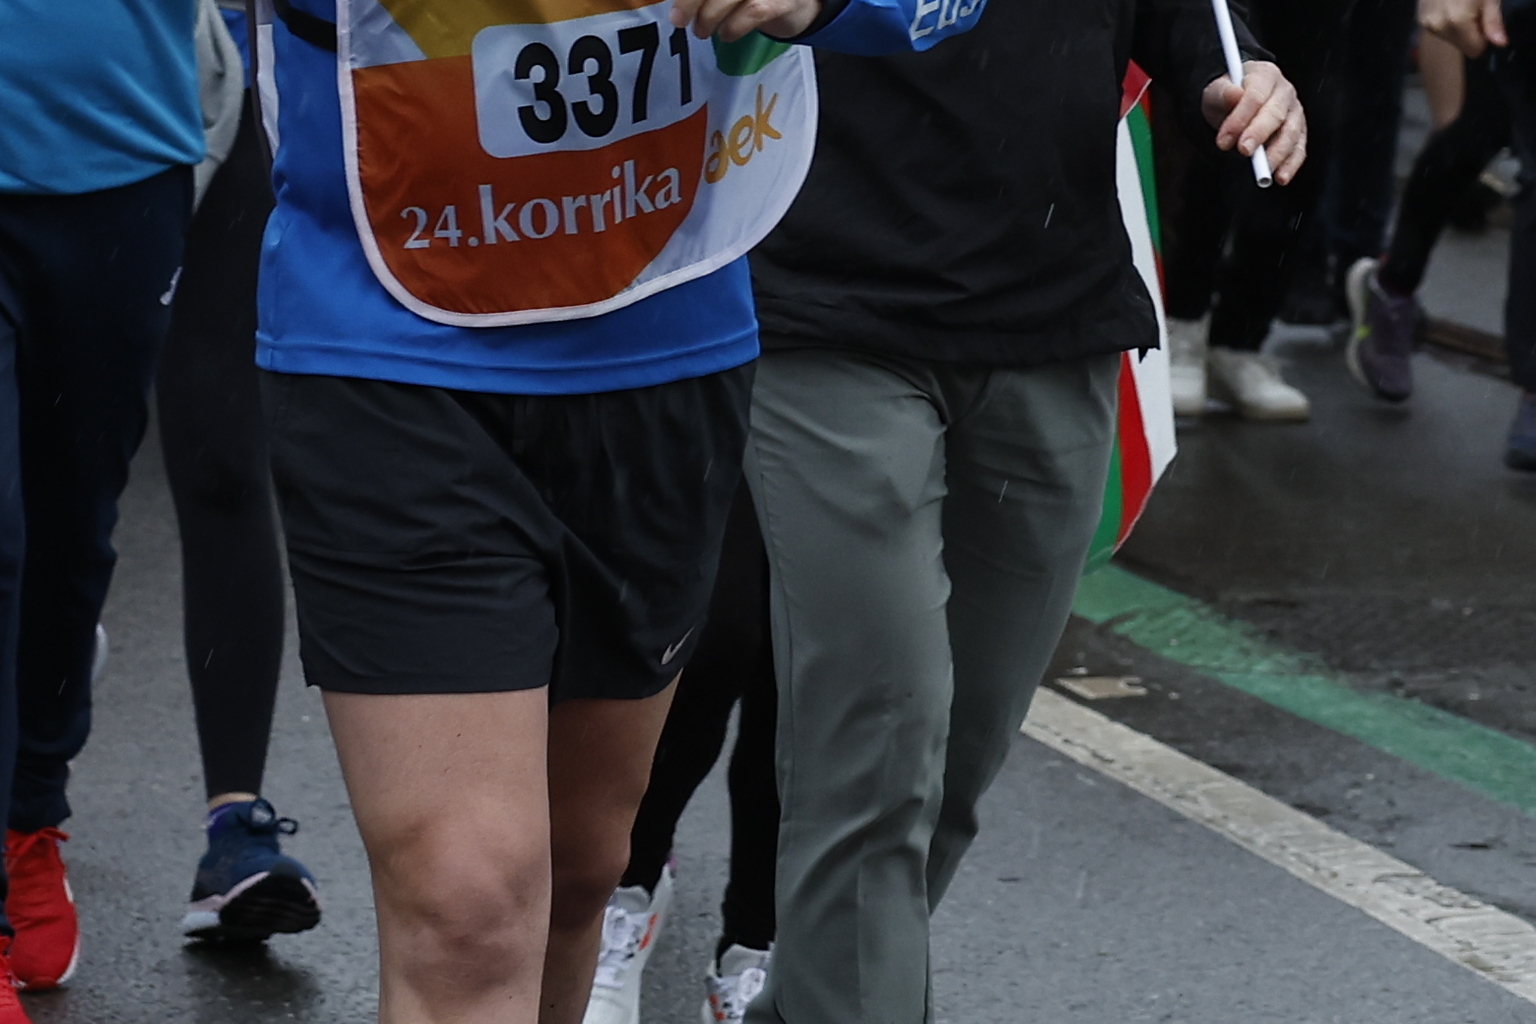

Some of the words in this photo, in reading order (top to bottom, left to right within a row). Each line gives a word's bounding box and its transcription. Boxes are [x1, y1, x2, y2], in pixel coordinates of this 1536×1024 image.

[514, 21, 693, 145] 3371
[400, 160, 682, 249] 24.korrika
[703, 83, 782, 184] aek
